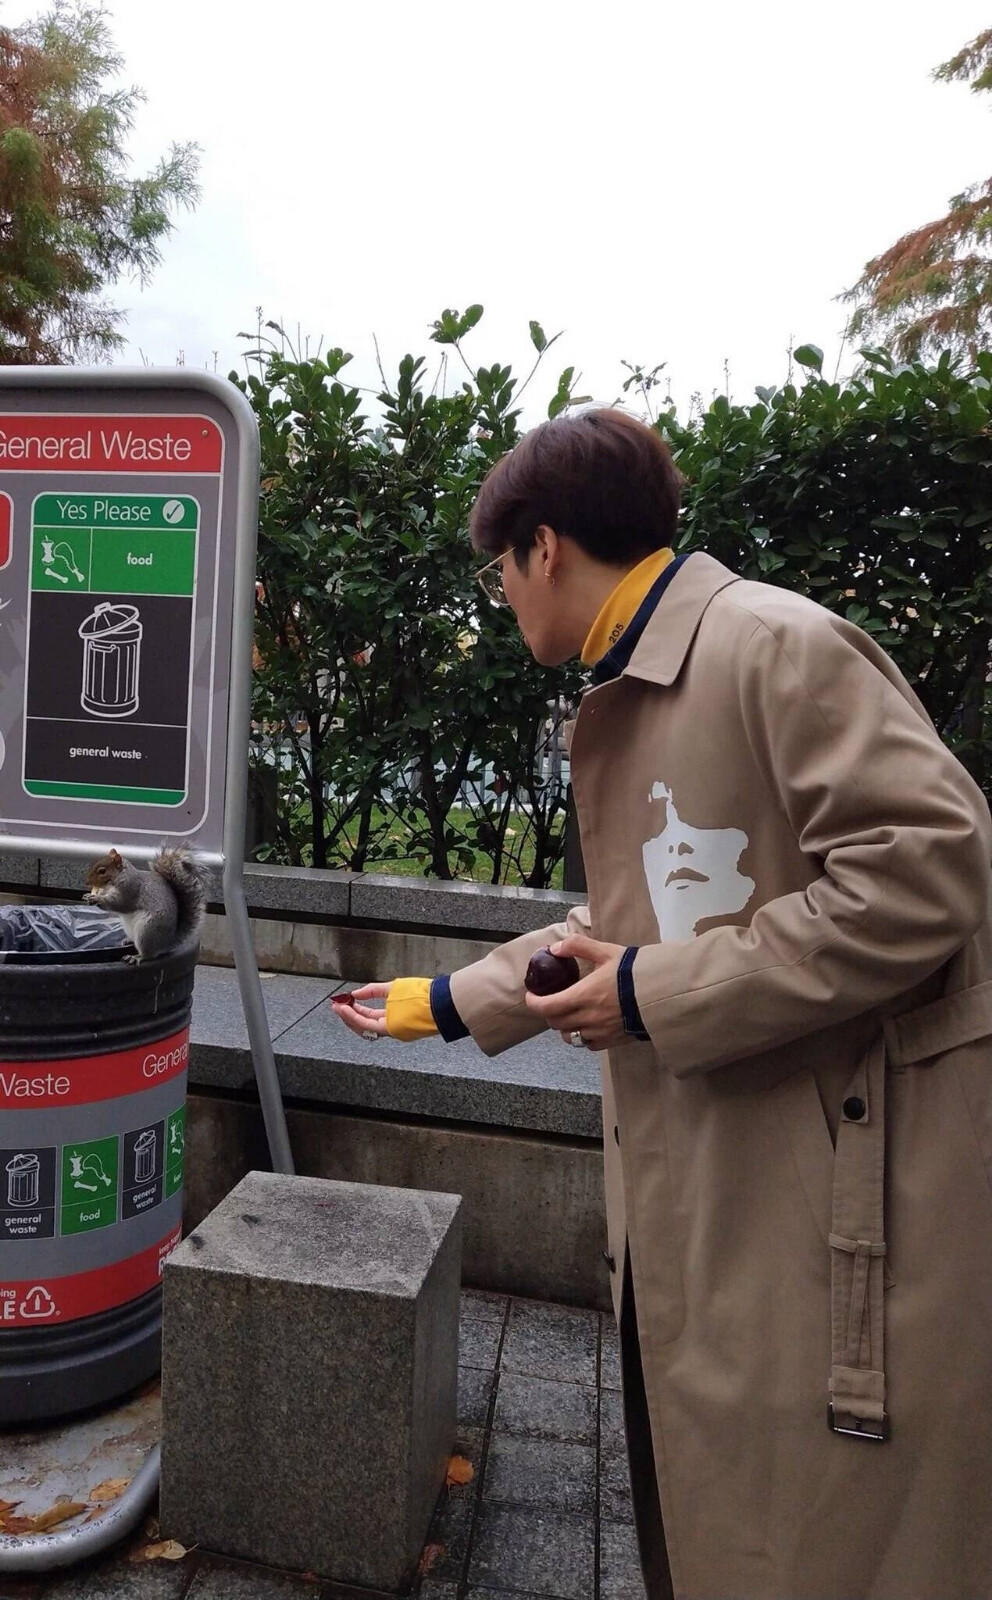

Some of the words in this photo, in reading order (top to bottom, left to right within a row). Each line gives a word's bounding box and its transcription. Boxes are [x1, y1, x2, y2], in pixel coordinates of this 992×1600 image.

[0, 430, 91, 460] eneral
[100, 430, 192, 461] Waste
[56, 499, 88, 520] Yes
[93, 499, 151, 521] Please
[126, 552, 153, 566] food
[69, 746, 109, 758] general
[111, 749, 142, 760] waste
[142, 1044, 188, 1078] Genera
[132, 1185, 157, 1203] general
[136, 1196, 154, 1210] waste
[4, 1213, 42, 1228] general
[79, 1209, 101, 1223] food
[9, 1225, 37, 1234] waste
